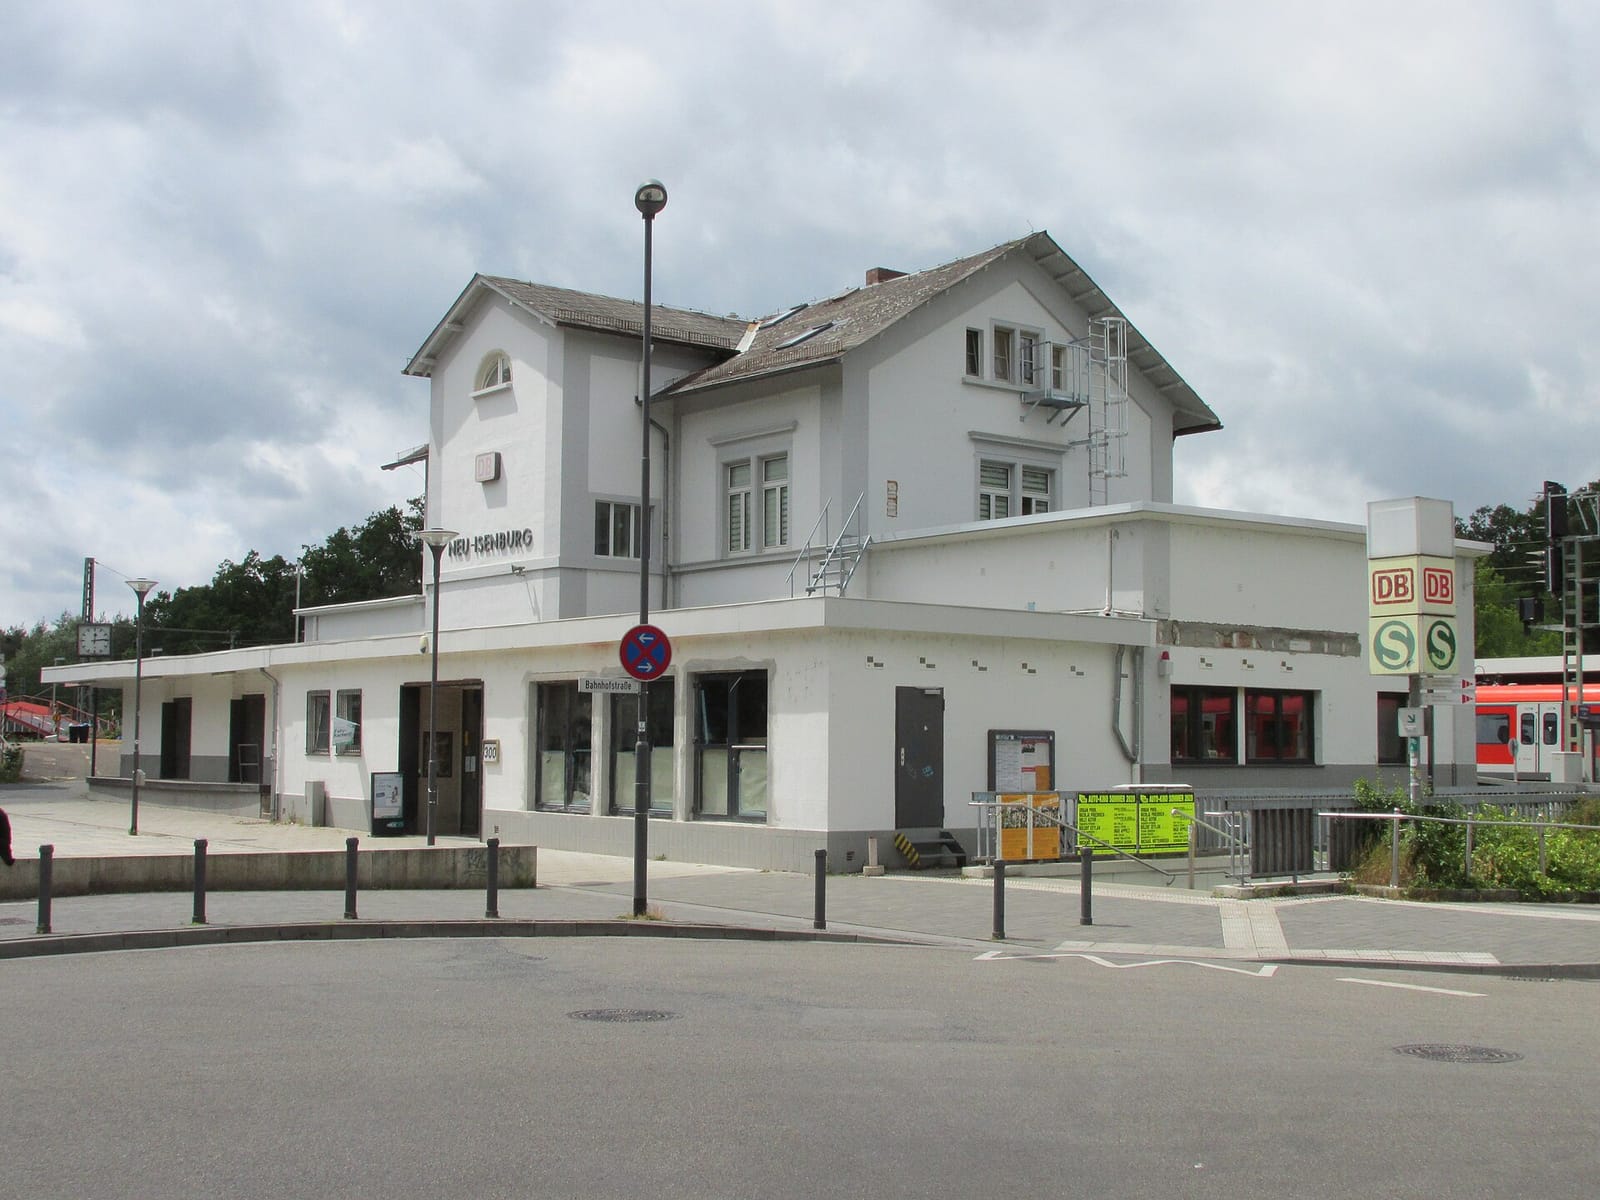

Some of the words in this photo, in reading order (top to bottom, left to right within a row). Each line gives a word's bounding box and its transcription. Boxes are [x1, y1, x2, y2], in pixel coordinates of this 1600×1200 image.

[448, 528, 533, 557] NEU-ISENBURG
[1377, 574, 1409, 599] DB
[1427, 573, 1450, 598] DB
[1380, 624, 1409, 666] S
[1431, 624, 1452, 666] S
[585, 680, 632, 690] Bahnhofstraße
[484, 746, 497, 759] 300
